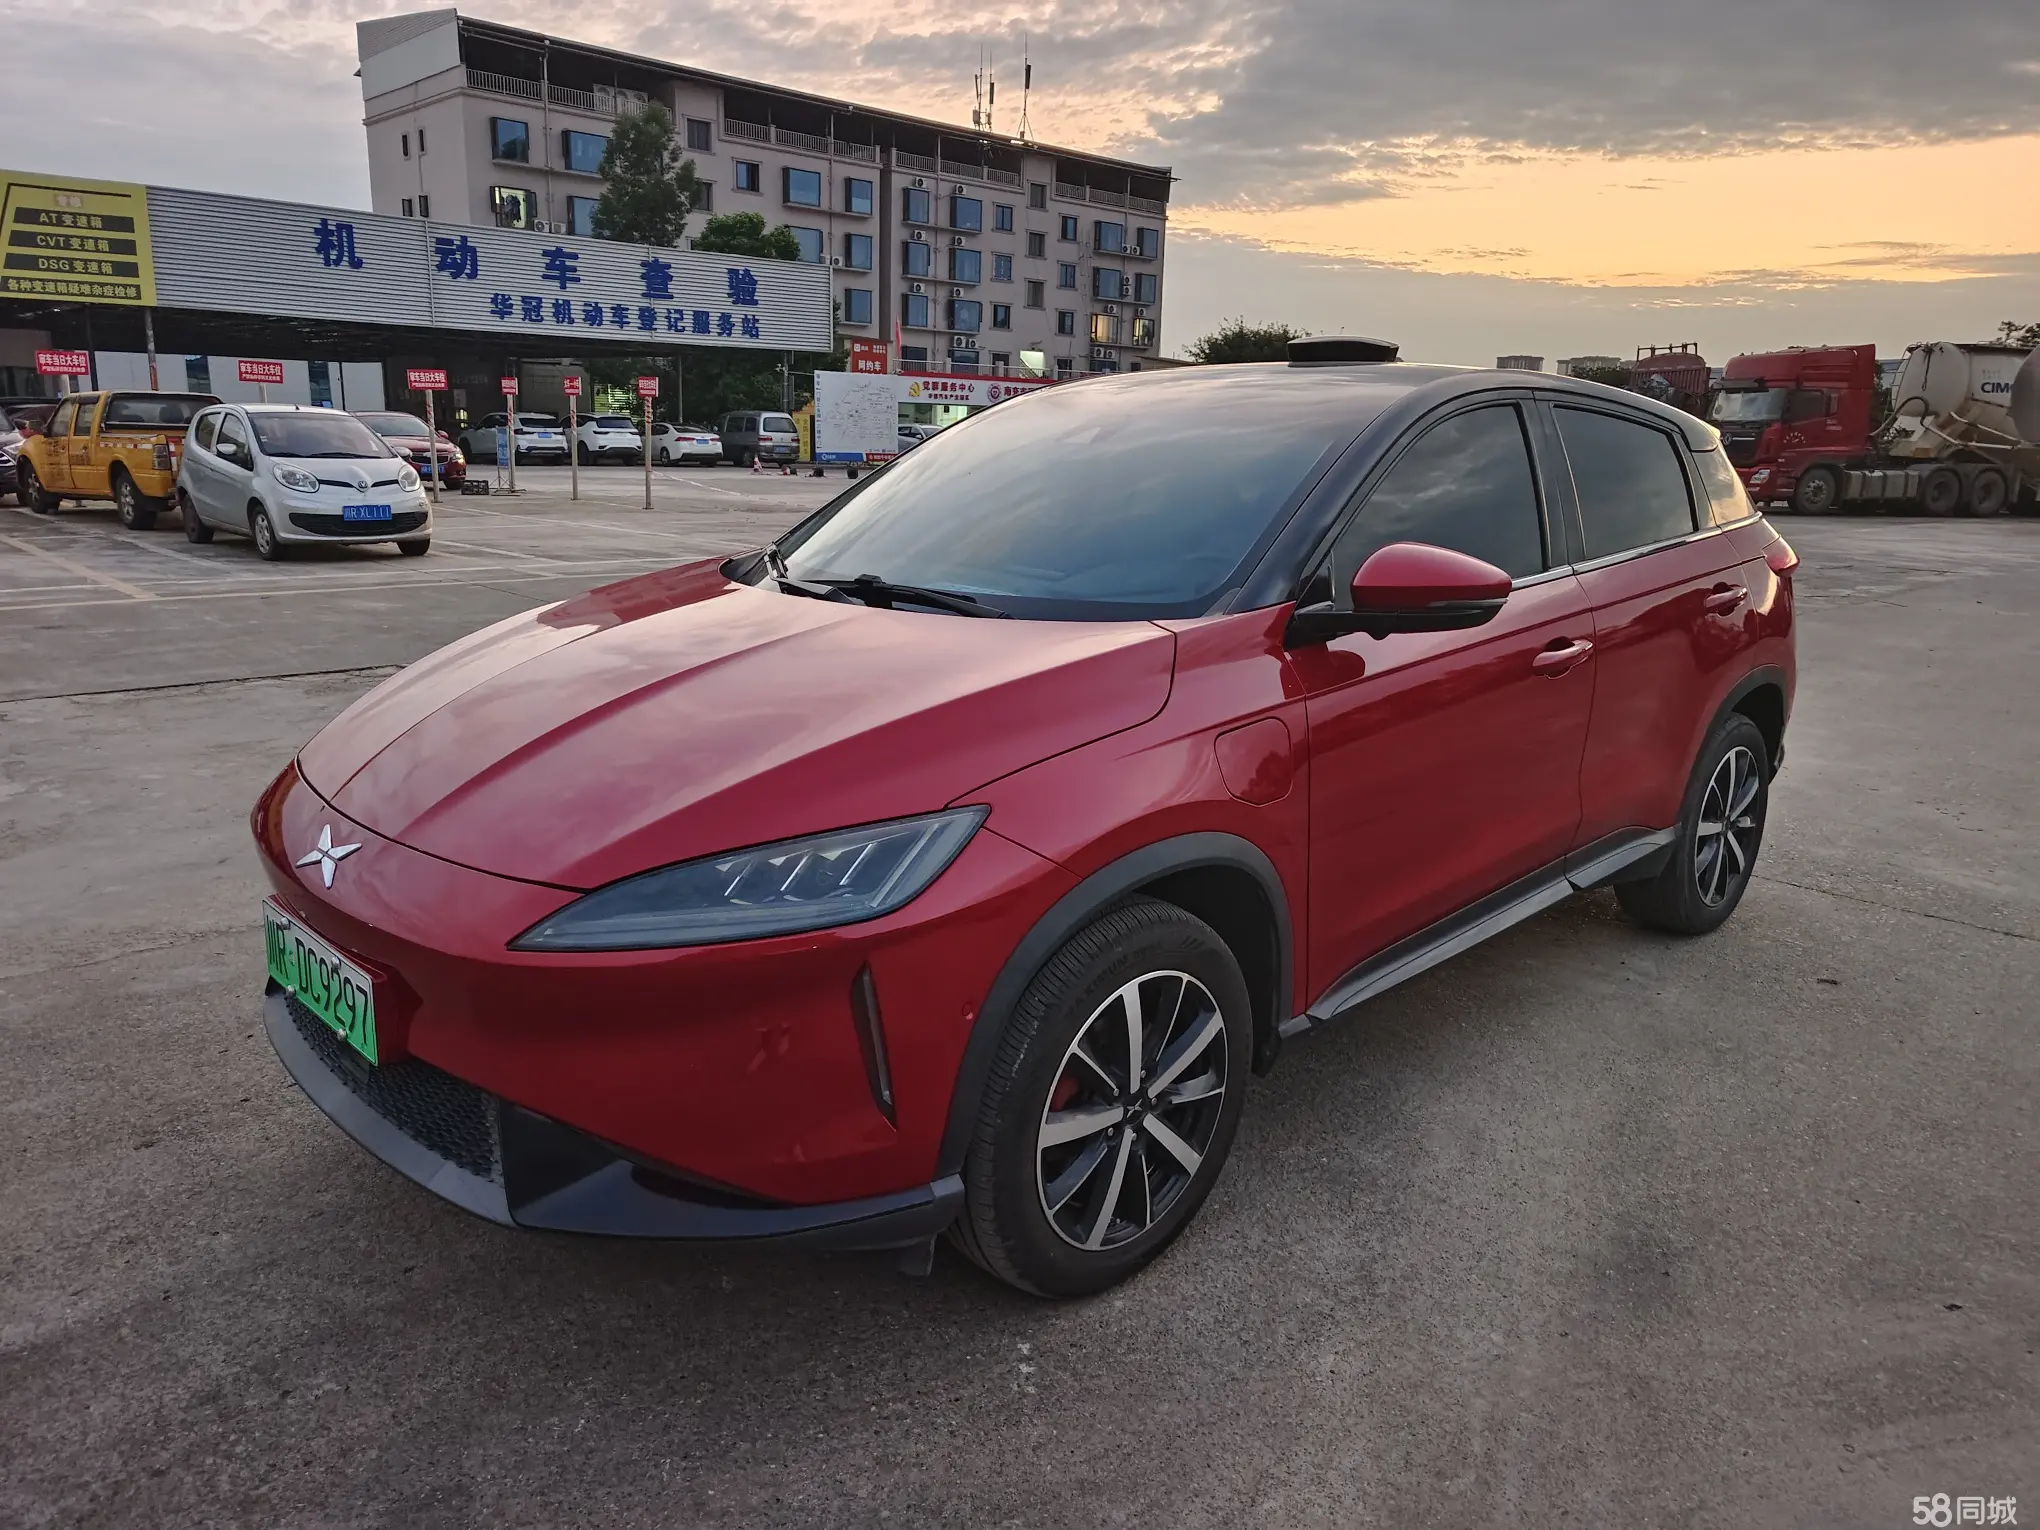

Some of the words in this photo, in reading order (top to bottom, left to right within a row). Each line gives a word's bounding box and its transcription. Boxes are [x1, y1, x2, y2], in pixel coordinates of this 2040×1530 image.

[489, 293, 760, 339] 华冠机动车登记服务站
[922, 380, 975, 393] 党群服务中心
